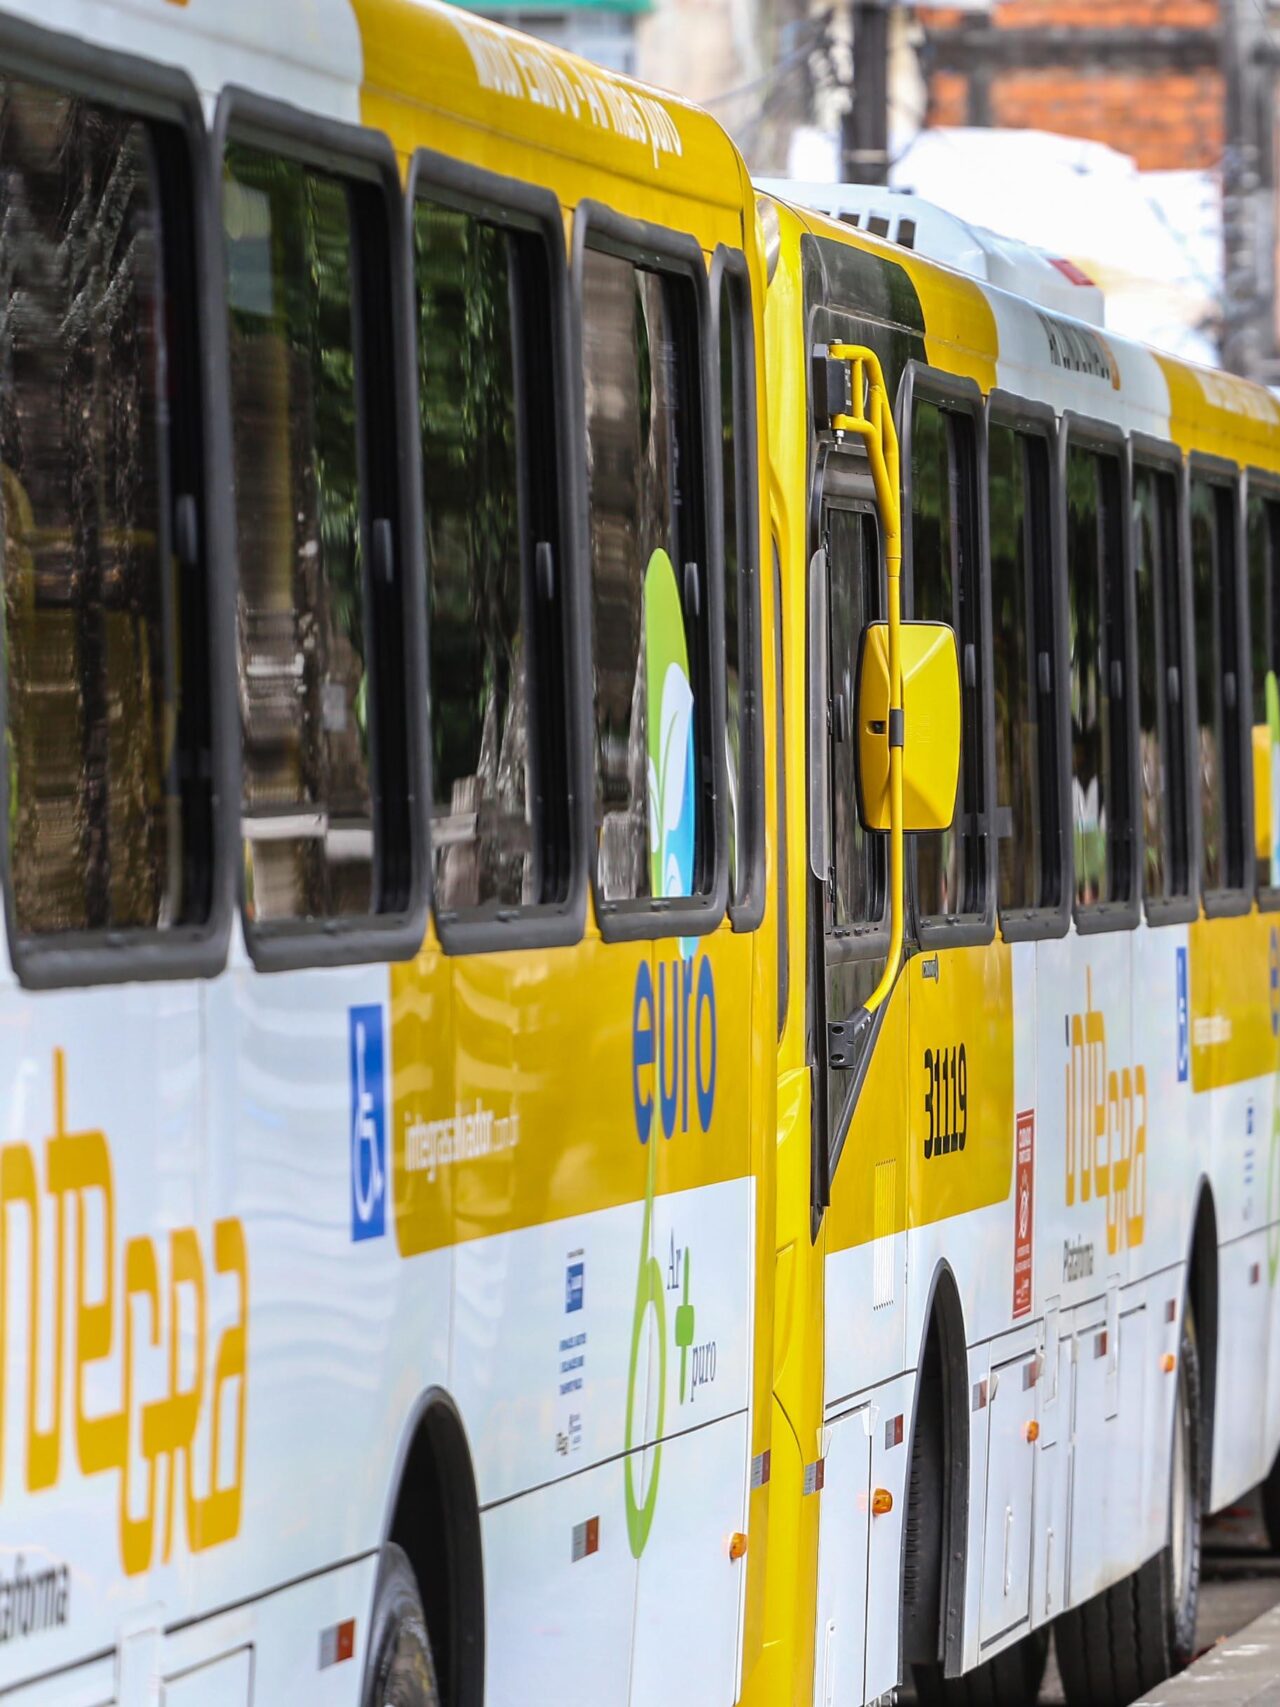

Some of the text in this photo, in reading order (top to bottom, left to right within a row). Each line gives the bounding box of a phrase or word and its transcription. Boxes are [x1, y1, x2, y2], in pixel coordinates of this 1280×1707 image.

[629, 91, 682, 169] puro
[632, 953, 717, 1145] euro
[923, 1042, 967, 1160] 31119
[666, 1226, 682, 1290] Ar
[690, 1340, 717, 1403] puro
